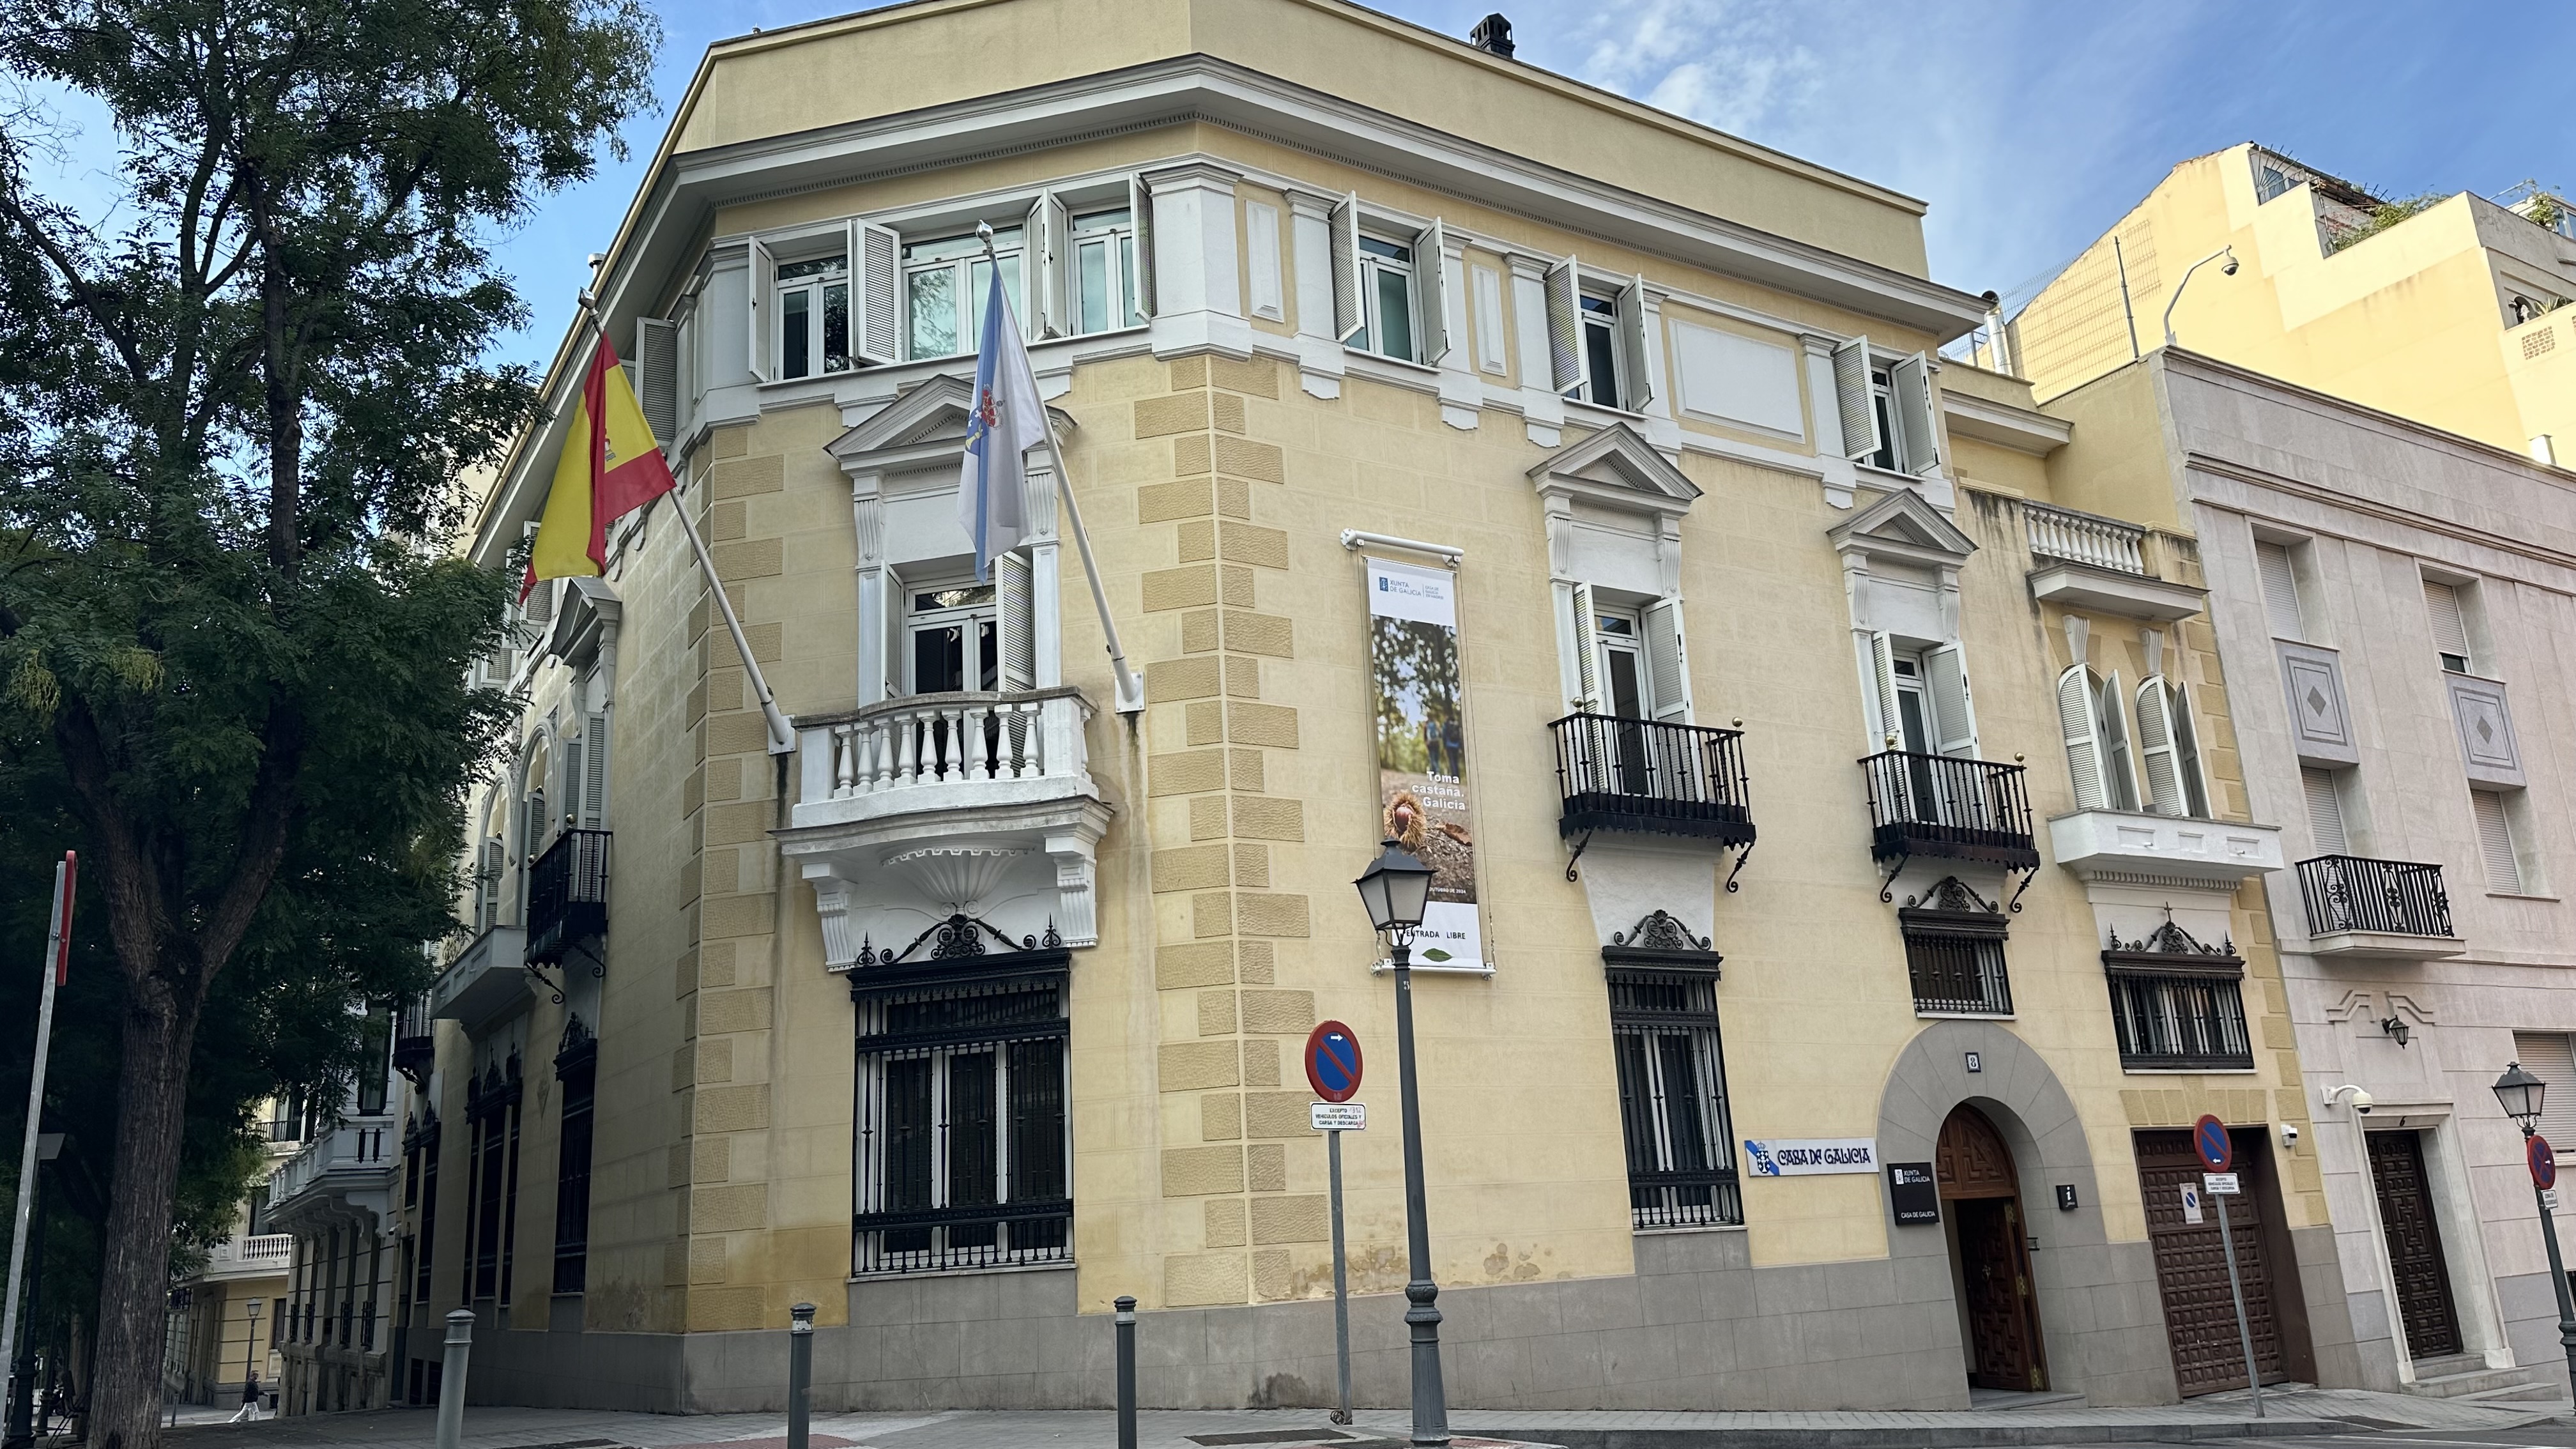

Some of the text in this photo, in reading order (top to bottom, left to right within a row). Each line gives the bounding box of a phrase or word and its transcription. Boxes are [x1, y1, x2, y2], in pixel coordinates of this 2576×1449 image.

[1390, 579, 1409, 588] XUNTA
[1399, 588, 1422, 597] GALICIA
[1426, 770, 1460, 784] Toma
[1411, 784, 1464, 797] castaña.
[1423, 797, 1466, 810] Galicia
[1406, 930, 1440, 938] ENTRADA
[1970, 1057, 1977, 1068] 8
[2399, 1115, 2407, 1127] 6
[1777, 1149, 1809, 1166] CASA
[1824, 1148, 1871, 1164] GALICIA
